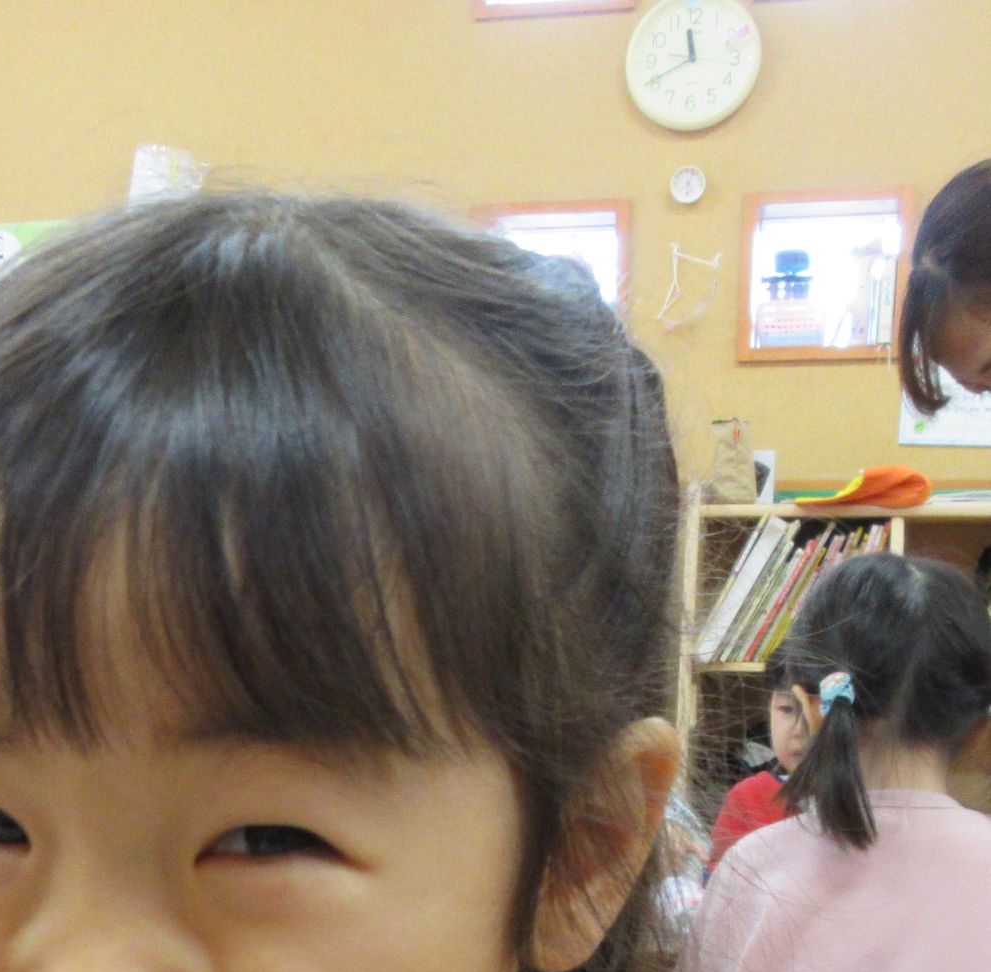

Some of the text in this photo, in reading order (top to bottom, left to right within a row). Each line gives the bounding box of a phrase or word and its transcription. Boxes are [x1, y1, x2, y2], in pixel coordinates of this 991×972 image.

[670, 15, 681, 30] 11
[689, 8, 703, 24] 12
[651, 31, 666, 48] 10
[646, 53, 657, 69] 9
[730, 49, 740, 65] 3
[723, 72, 732, 88] 4
[665, 90, 676, 106] 7
[685, 95, 696, 111] 6
[706, 88, 717, 104] 5
